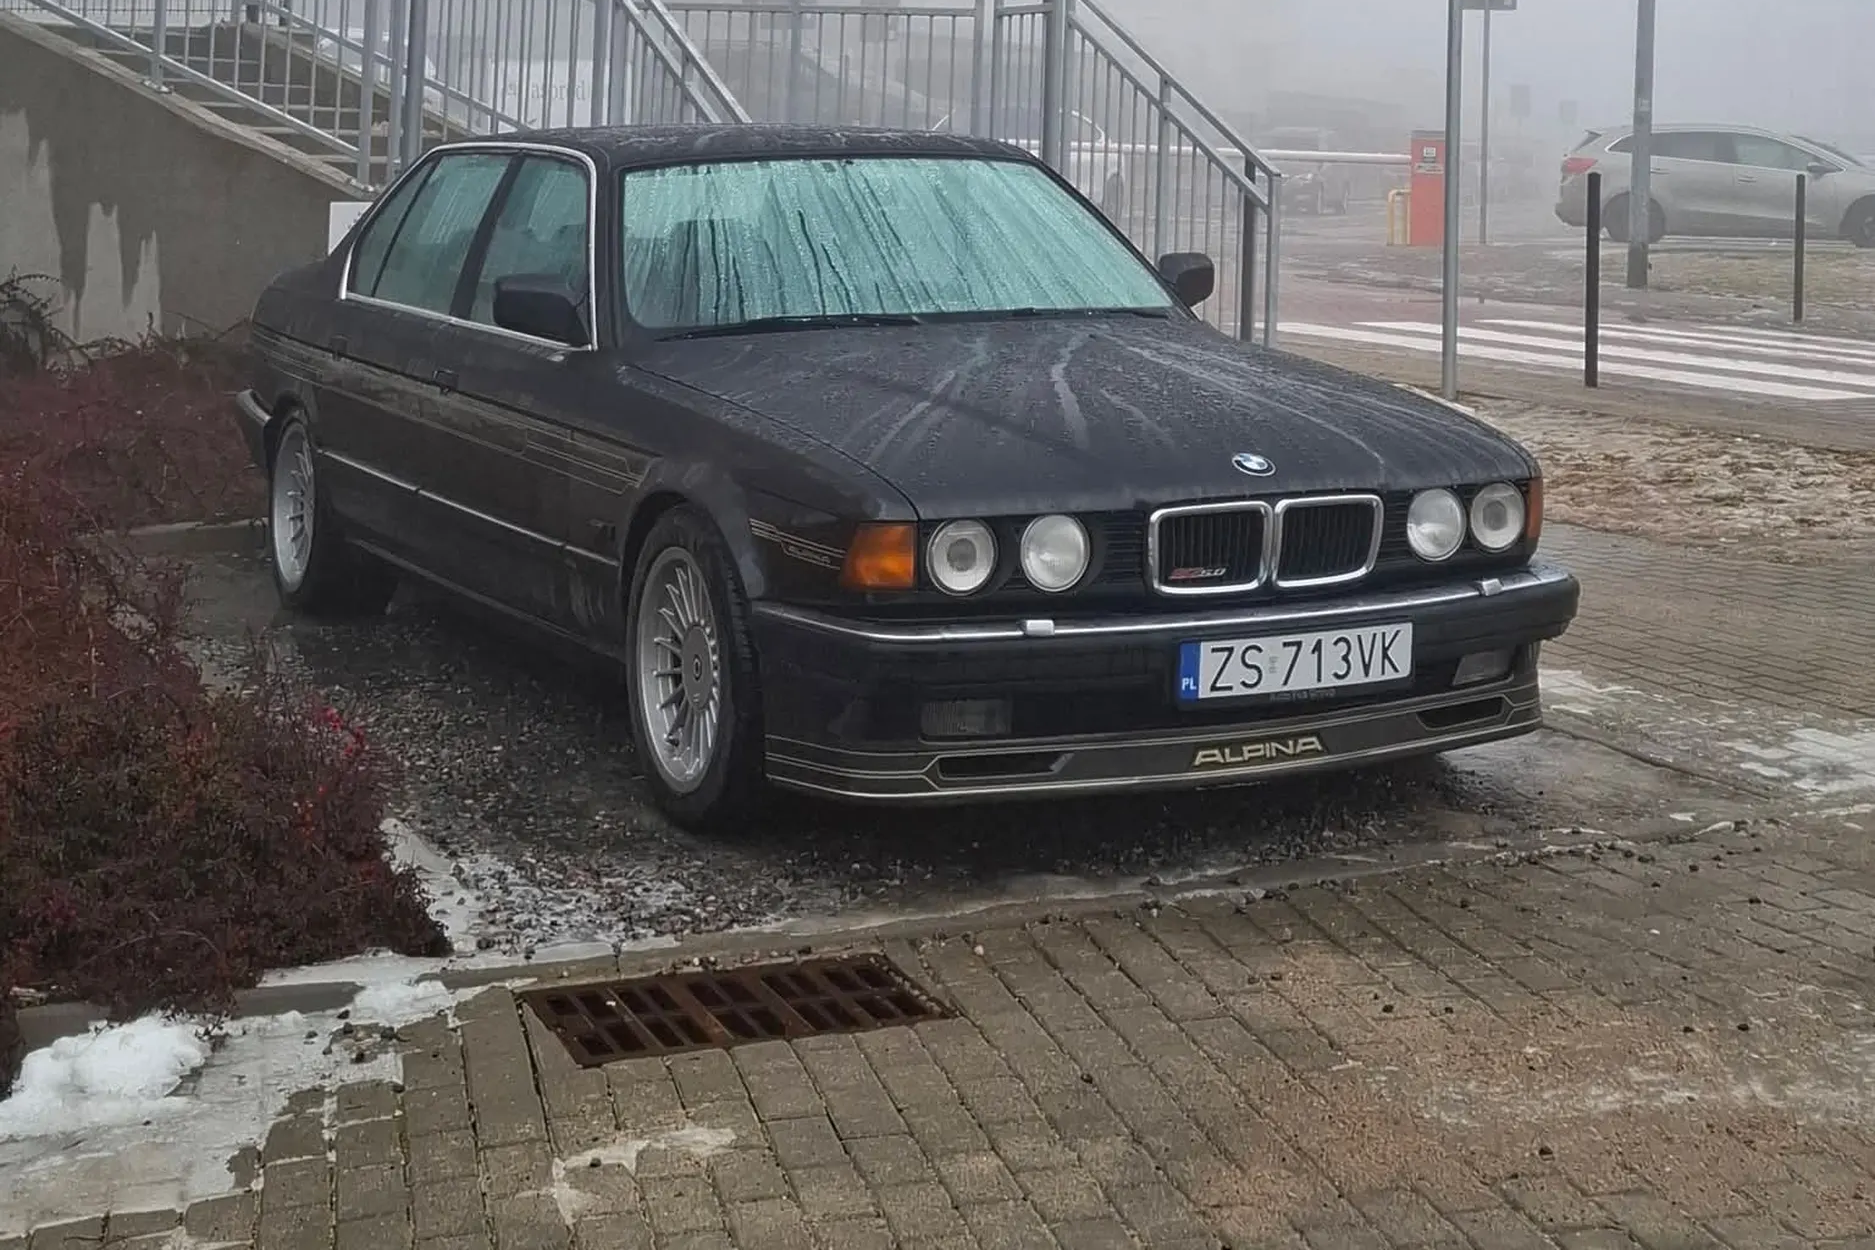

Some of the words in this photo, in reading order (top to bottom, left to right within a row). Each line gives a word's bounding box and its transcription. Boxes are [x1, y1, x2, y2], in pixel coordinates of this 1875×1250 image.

[1209, 644, 1264, 692] ZS
[1281, 629, 1402, 686] 713VK
[1181, 676, 1198, 691] PL
[1193, 736, 1323, 766] ALPINA
